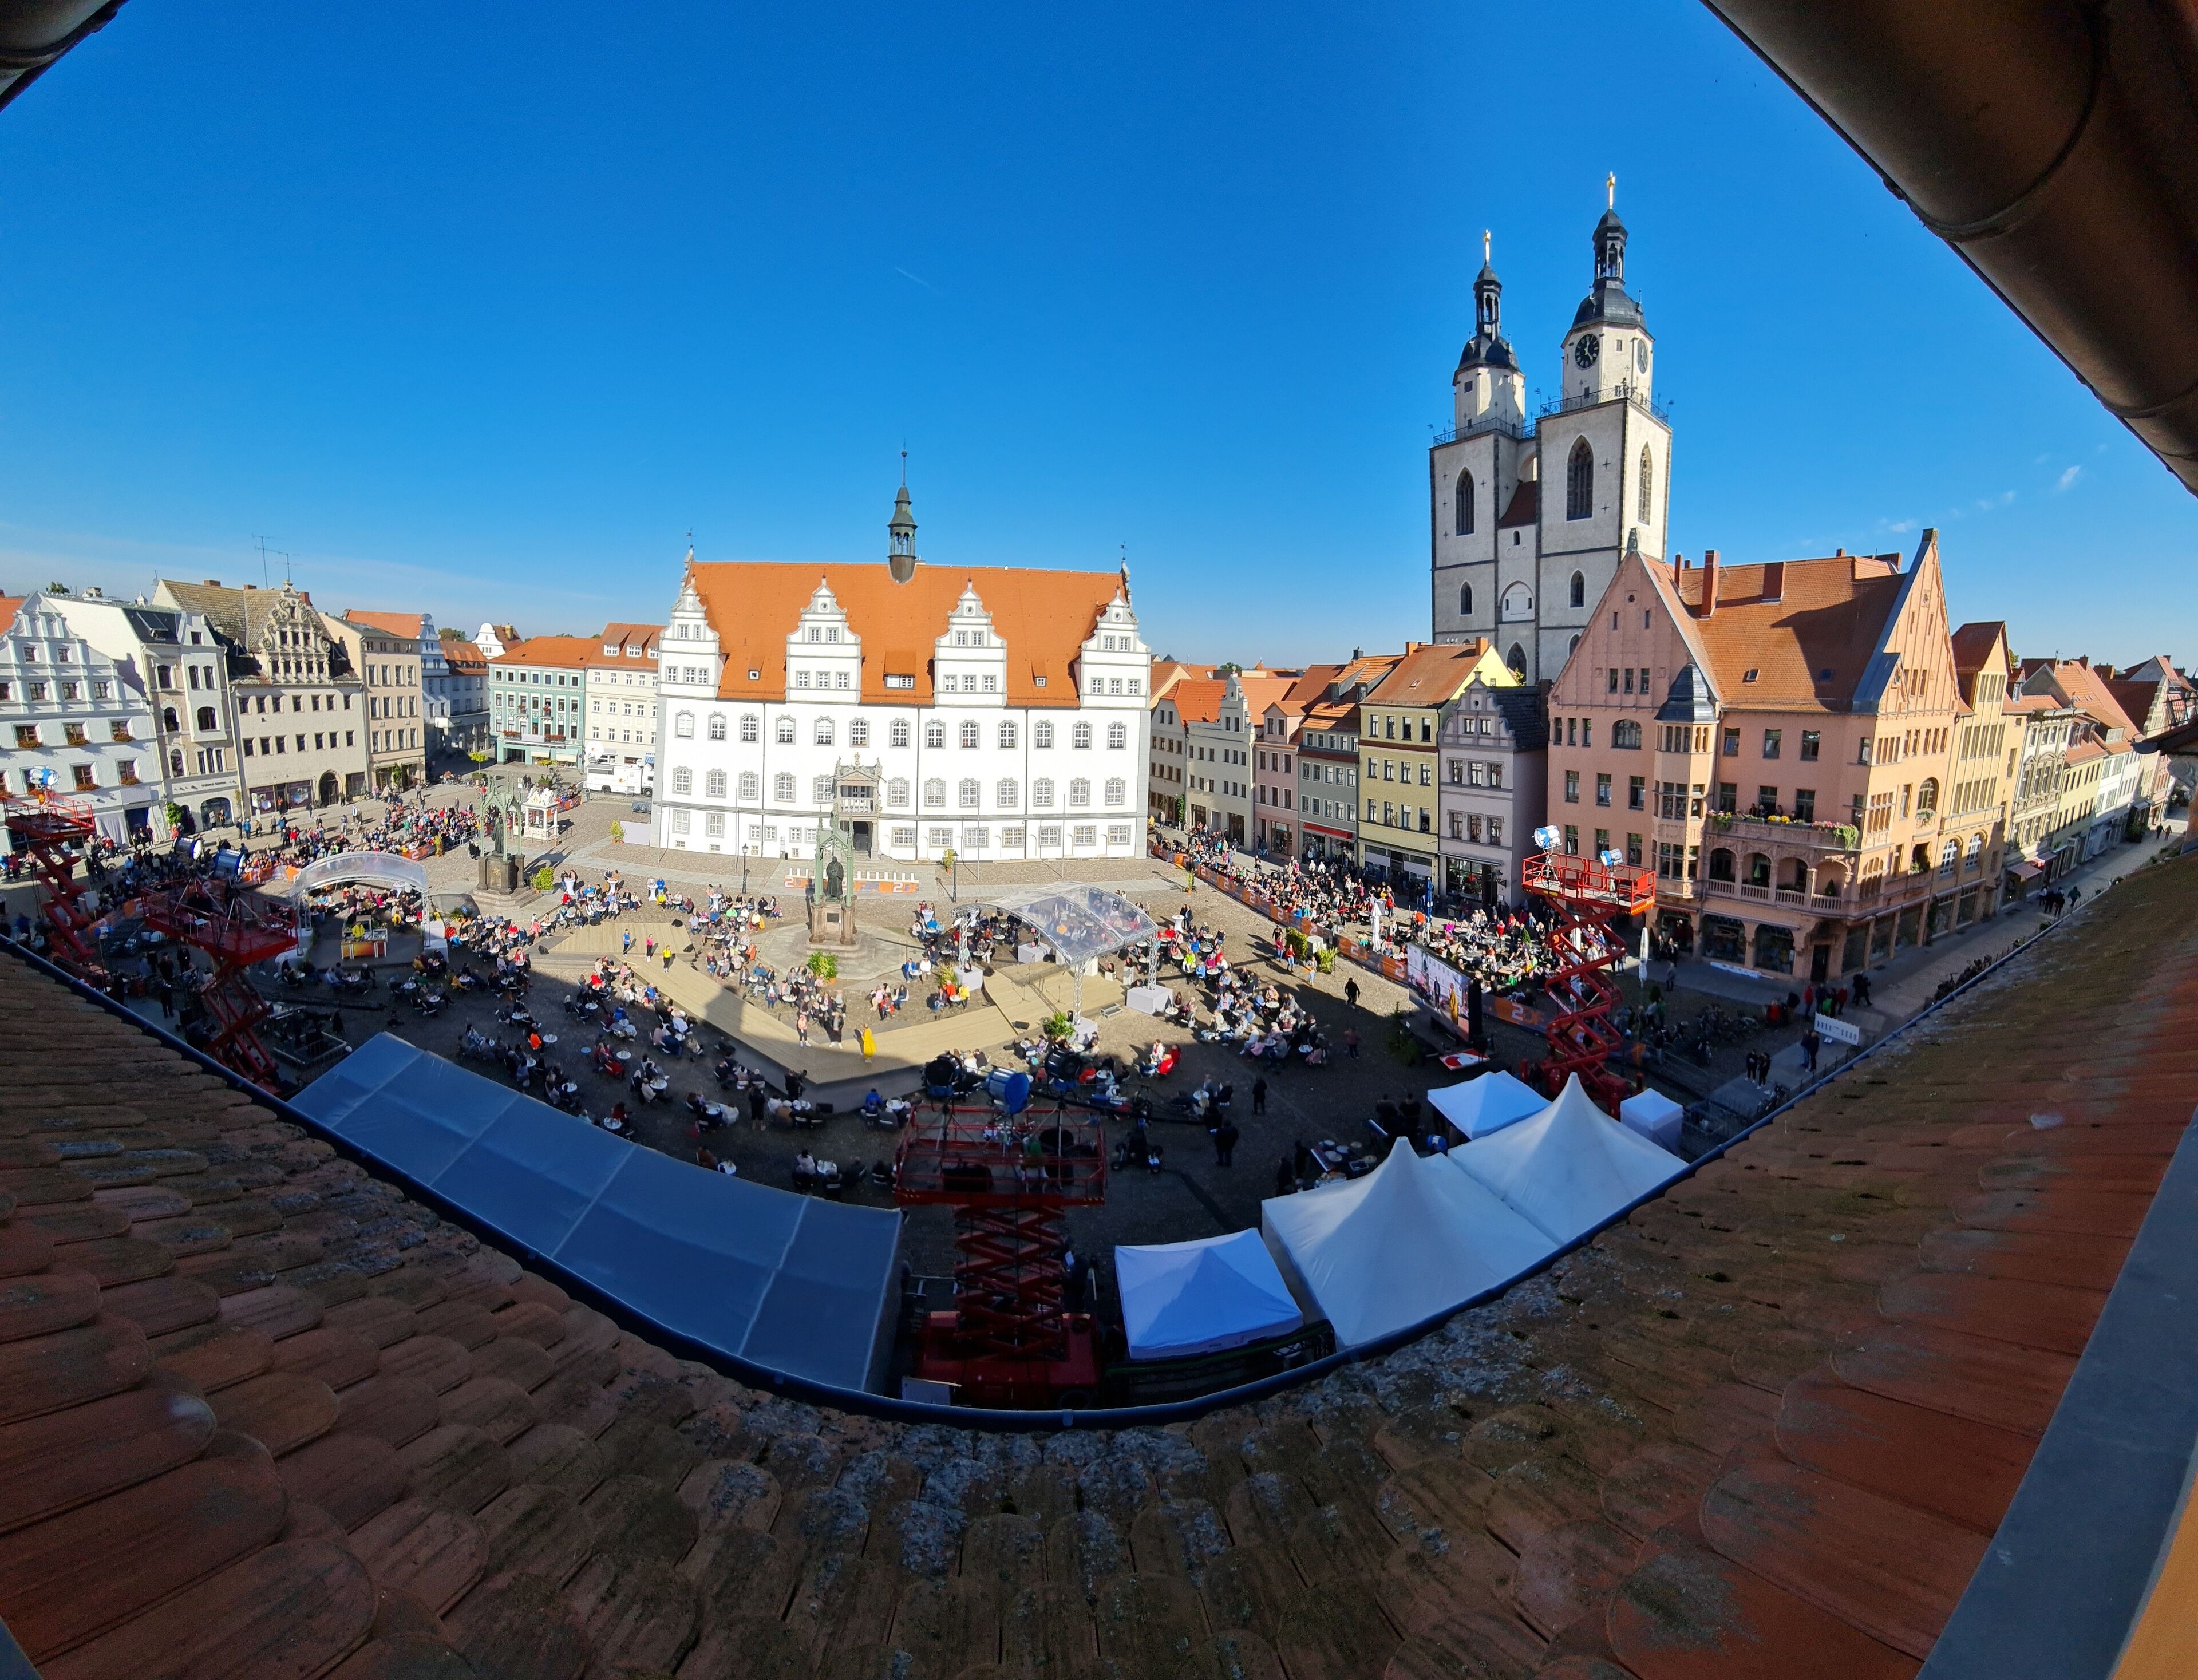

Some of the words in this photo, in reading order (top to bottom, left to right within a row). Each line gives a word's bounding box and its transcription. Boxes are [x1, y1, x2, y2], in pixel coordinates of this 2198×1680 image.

[785, 877, 794, 888] 2
[893, 882, 903, 892] 2
[1350, 942, 1359, 955] 2
[1395, 962, 1404, 978] 2
[1511, 1003, 1523, 1021] 2
